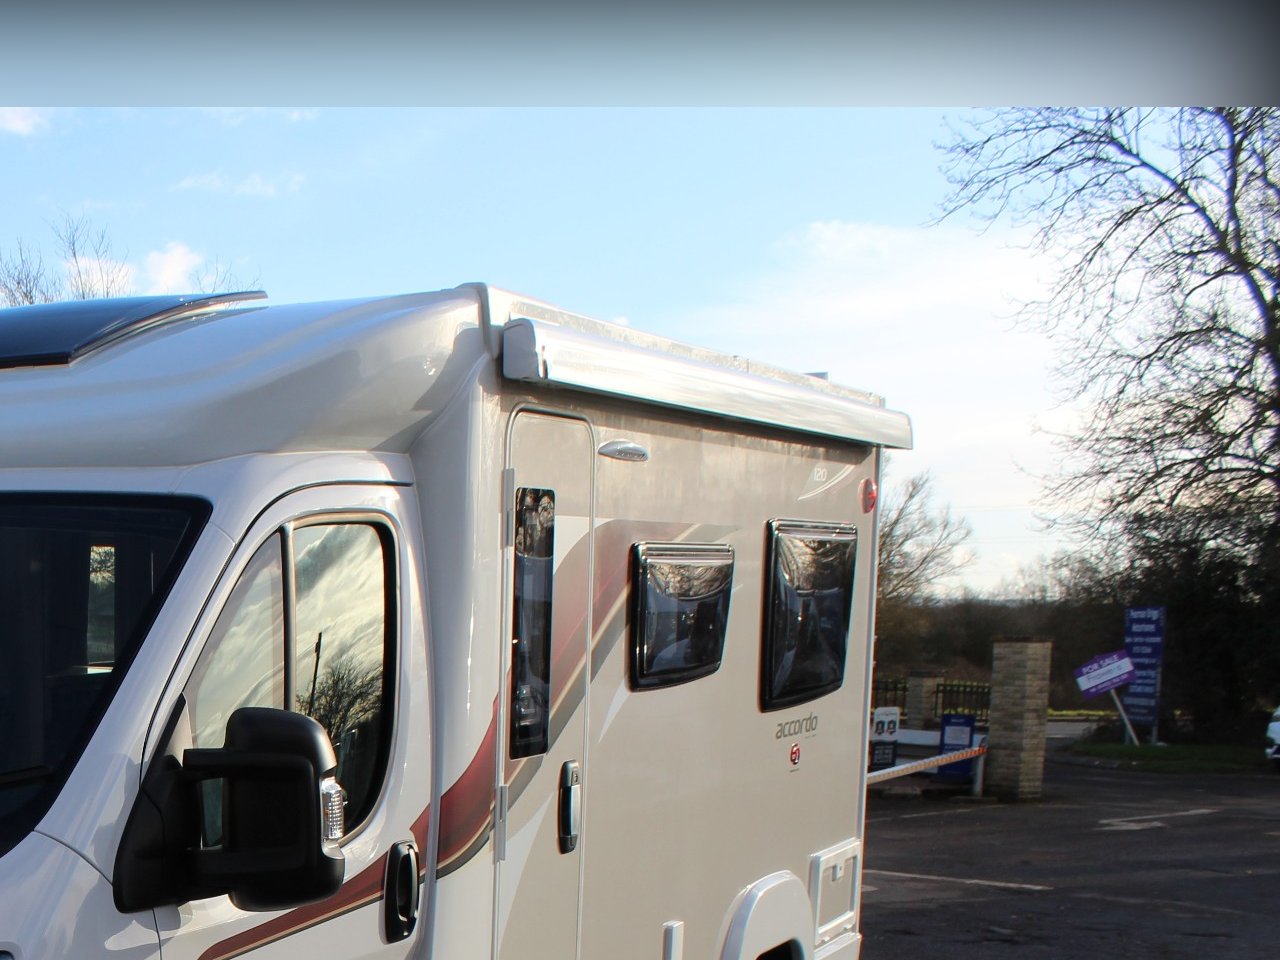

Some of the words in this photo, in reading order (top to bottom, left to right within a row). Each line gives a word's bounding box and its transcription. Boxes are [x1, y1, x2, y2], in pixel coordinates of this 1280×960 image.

[1081, 662, 1099, 675] FOR
[1100, 653, 1120, 667] SALE
[775, 712, 818, 740] accordo
